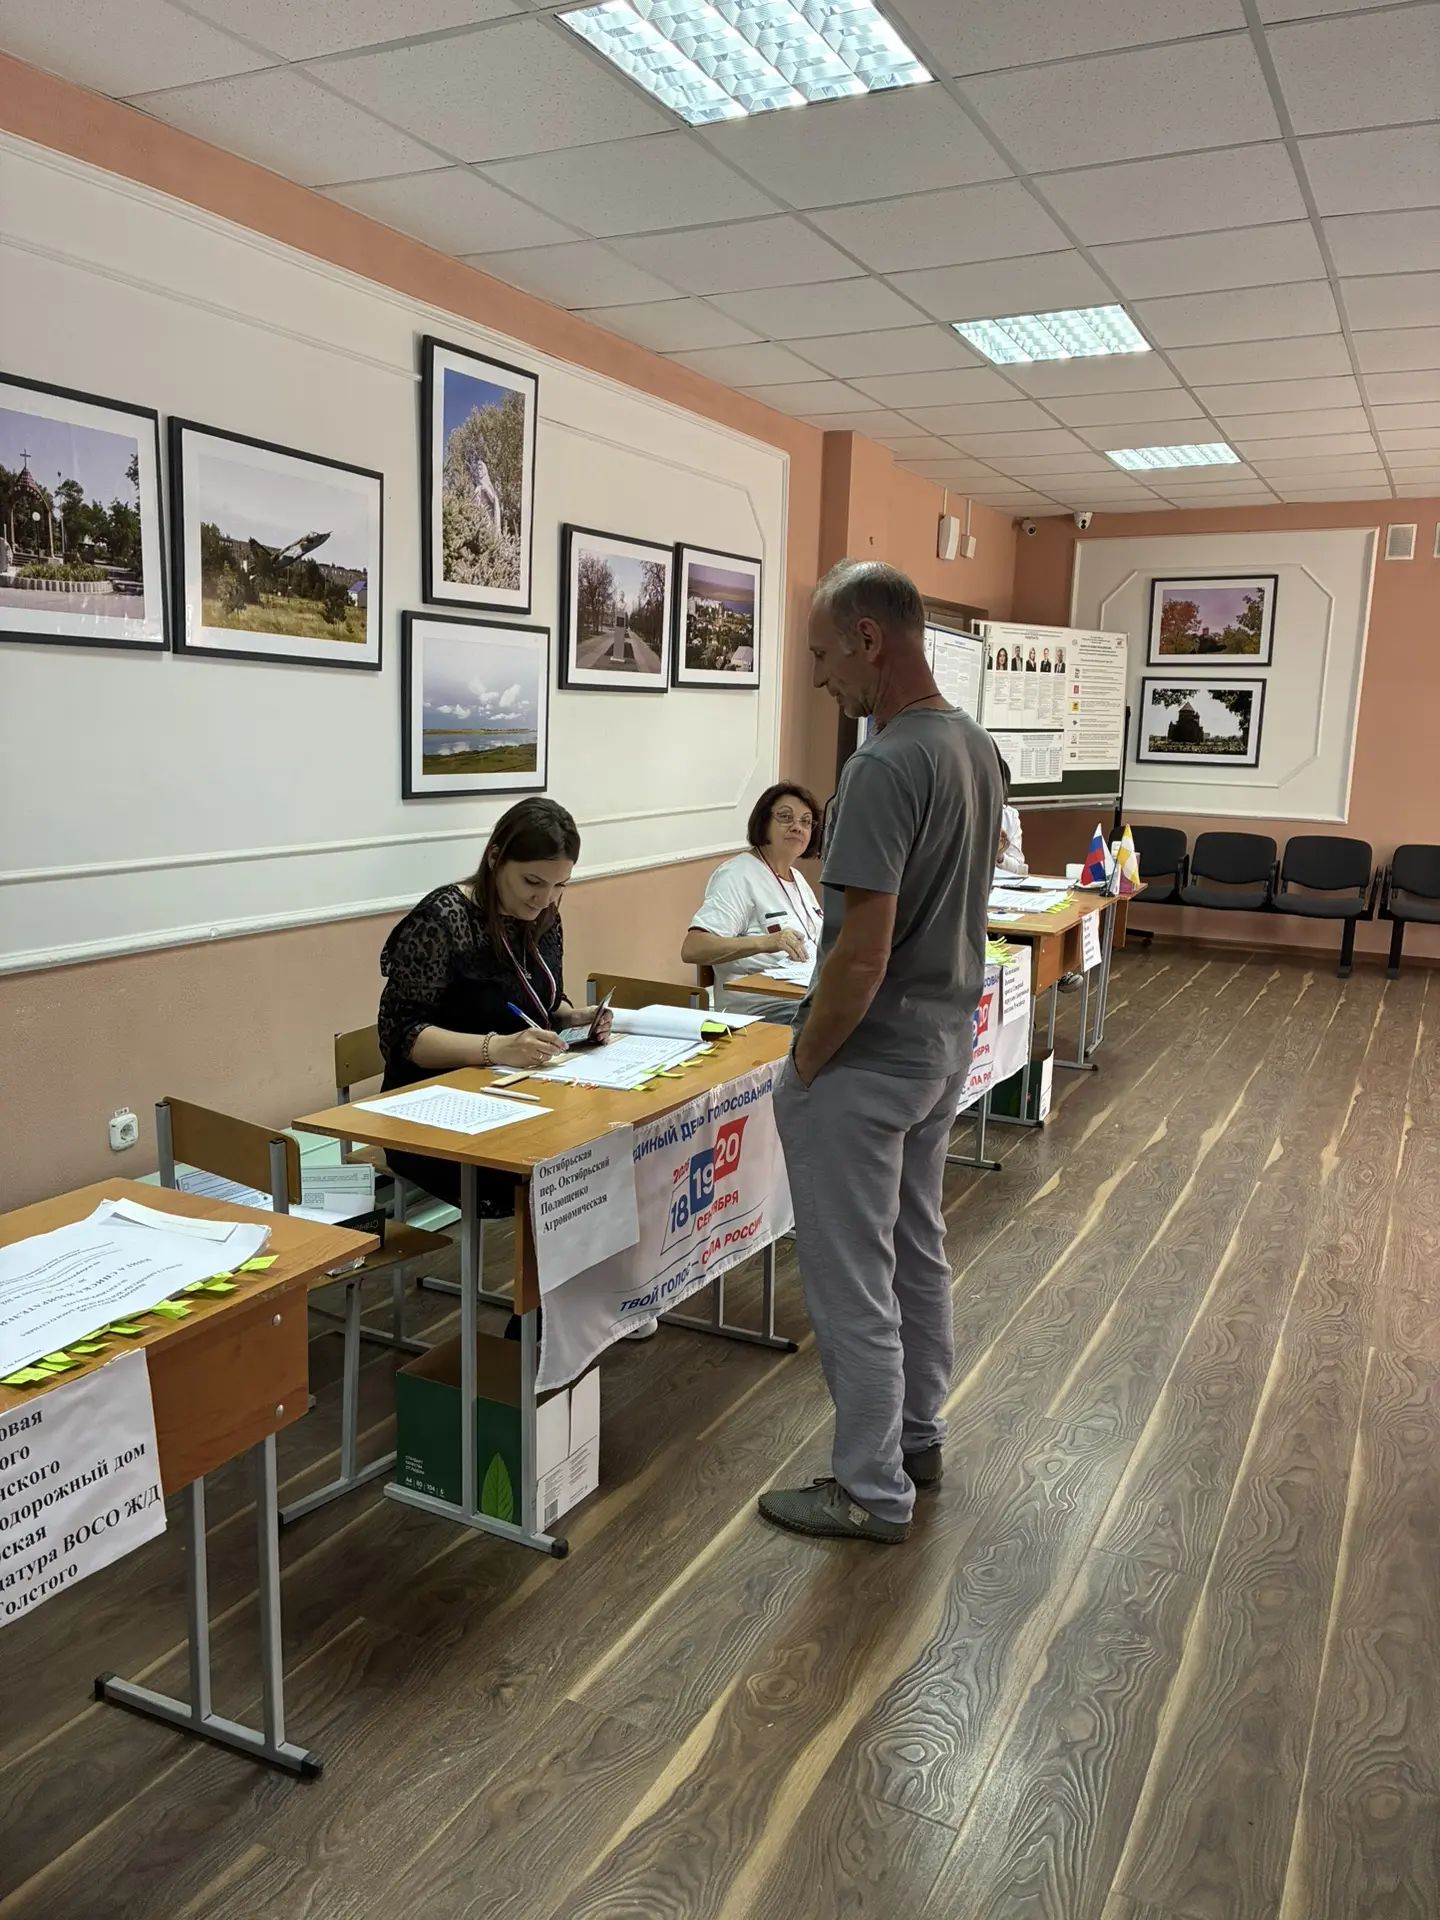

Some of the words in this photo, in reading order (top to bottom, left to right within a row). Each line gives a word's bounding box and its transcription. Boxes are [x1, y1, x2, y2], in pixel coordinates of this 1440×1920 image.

[633, 1124, 678, 1164] ДИНЫЙ
[540, 1149, 592, 1179] Октябрьская
[540, 1183, 557, 1197] пер.
[558, 1156, 610, 1188] Октябрьский
[671, 1194, 689, 1233] 18
[693, 1162, 714, 1200] 19
[715, 1132, 740, 1169] 20
[543, 1194, 608, 1233] Агрономическая
[697, 1189, 739, 1231] СЕНЯБРЯ
[620, 1285, 659, 1312] ТВОЙ
[114, 1443, 146, 1472] дом
[63, 1508, 120, 1554] ВОСО
[124, 1484, 161, 1518] Ж/Д
[0, 1526, 47, 1560] ская
